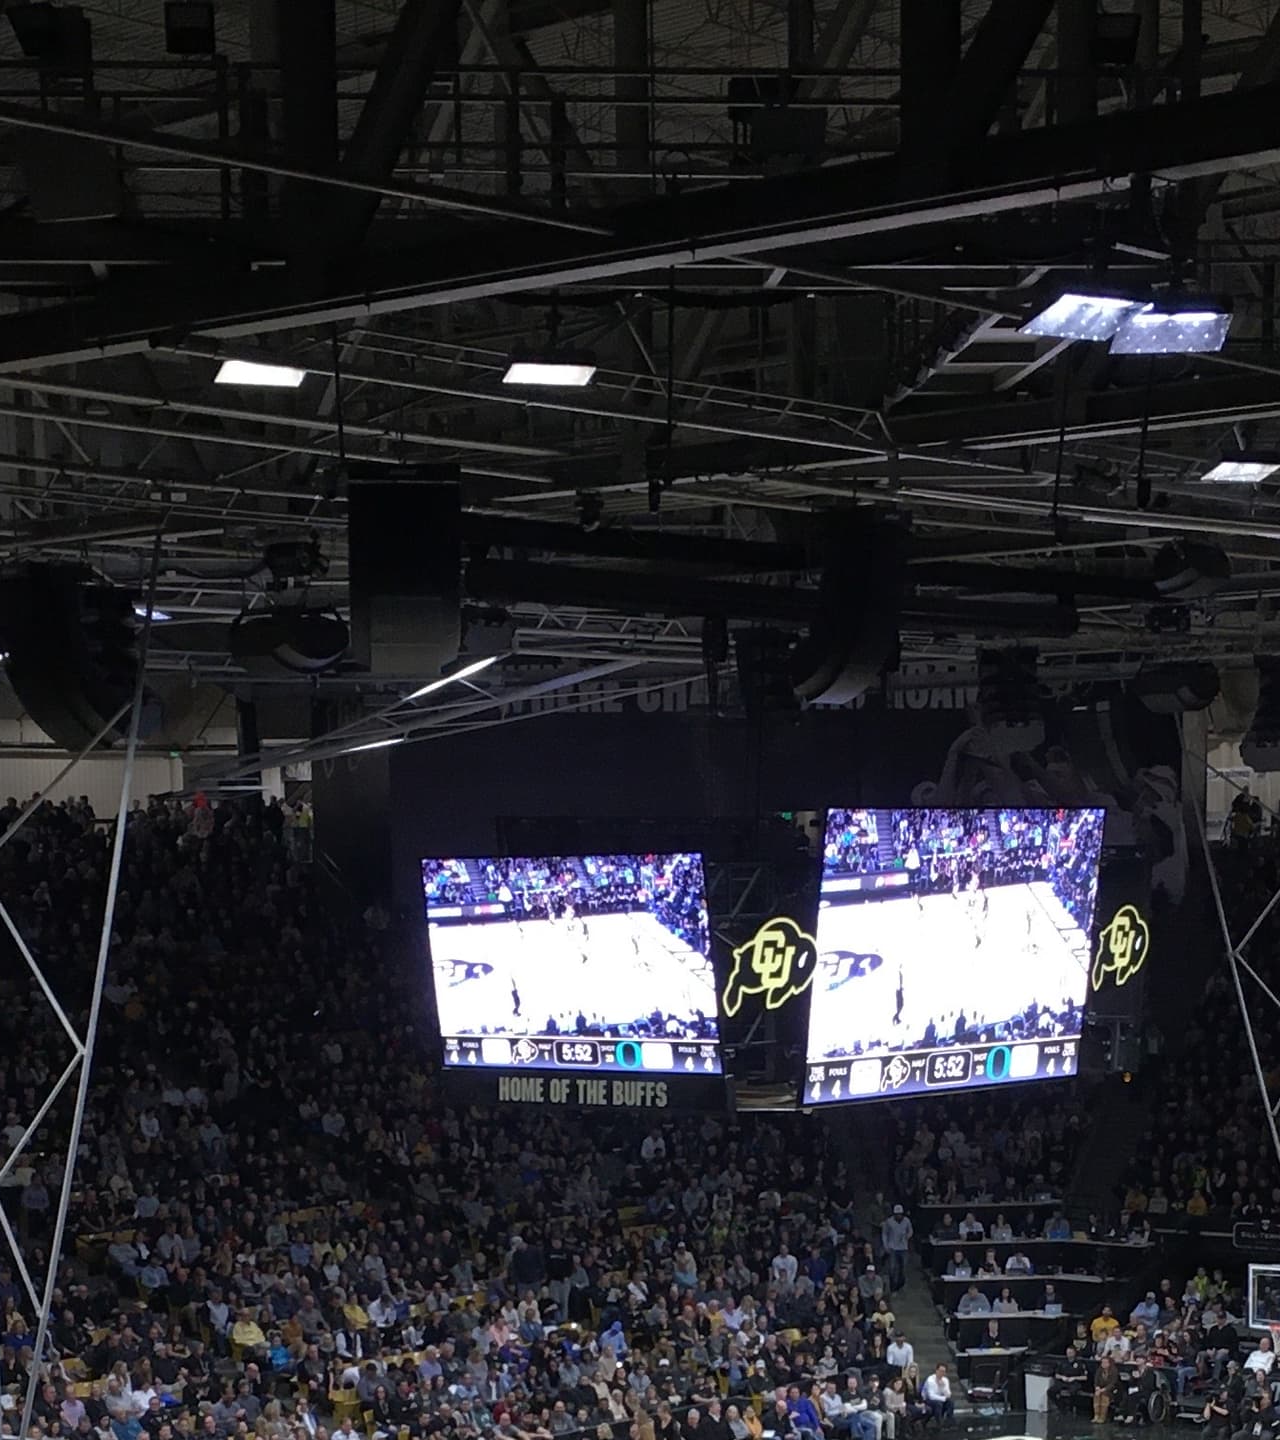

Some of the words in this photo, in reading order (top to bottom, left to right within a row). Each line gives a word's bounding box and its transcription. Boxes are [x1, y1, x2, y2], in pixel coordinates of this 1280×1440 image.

[562, 1043, 592, 1063] 5:52
[933, 1055, 965, 1079] 5:52
[498, 1076, 544, 1102] HOME
[549, 1078, 571, 1104] OF
[576, 1079, 608, 1105] THE
[612, 1080, 668, 1108] BUFFS
